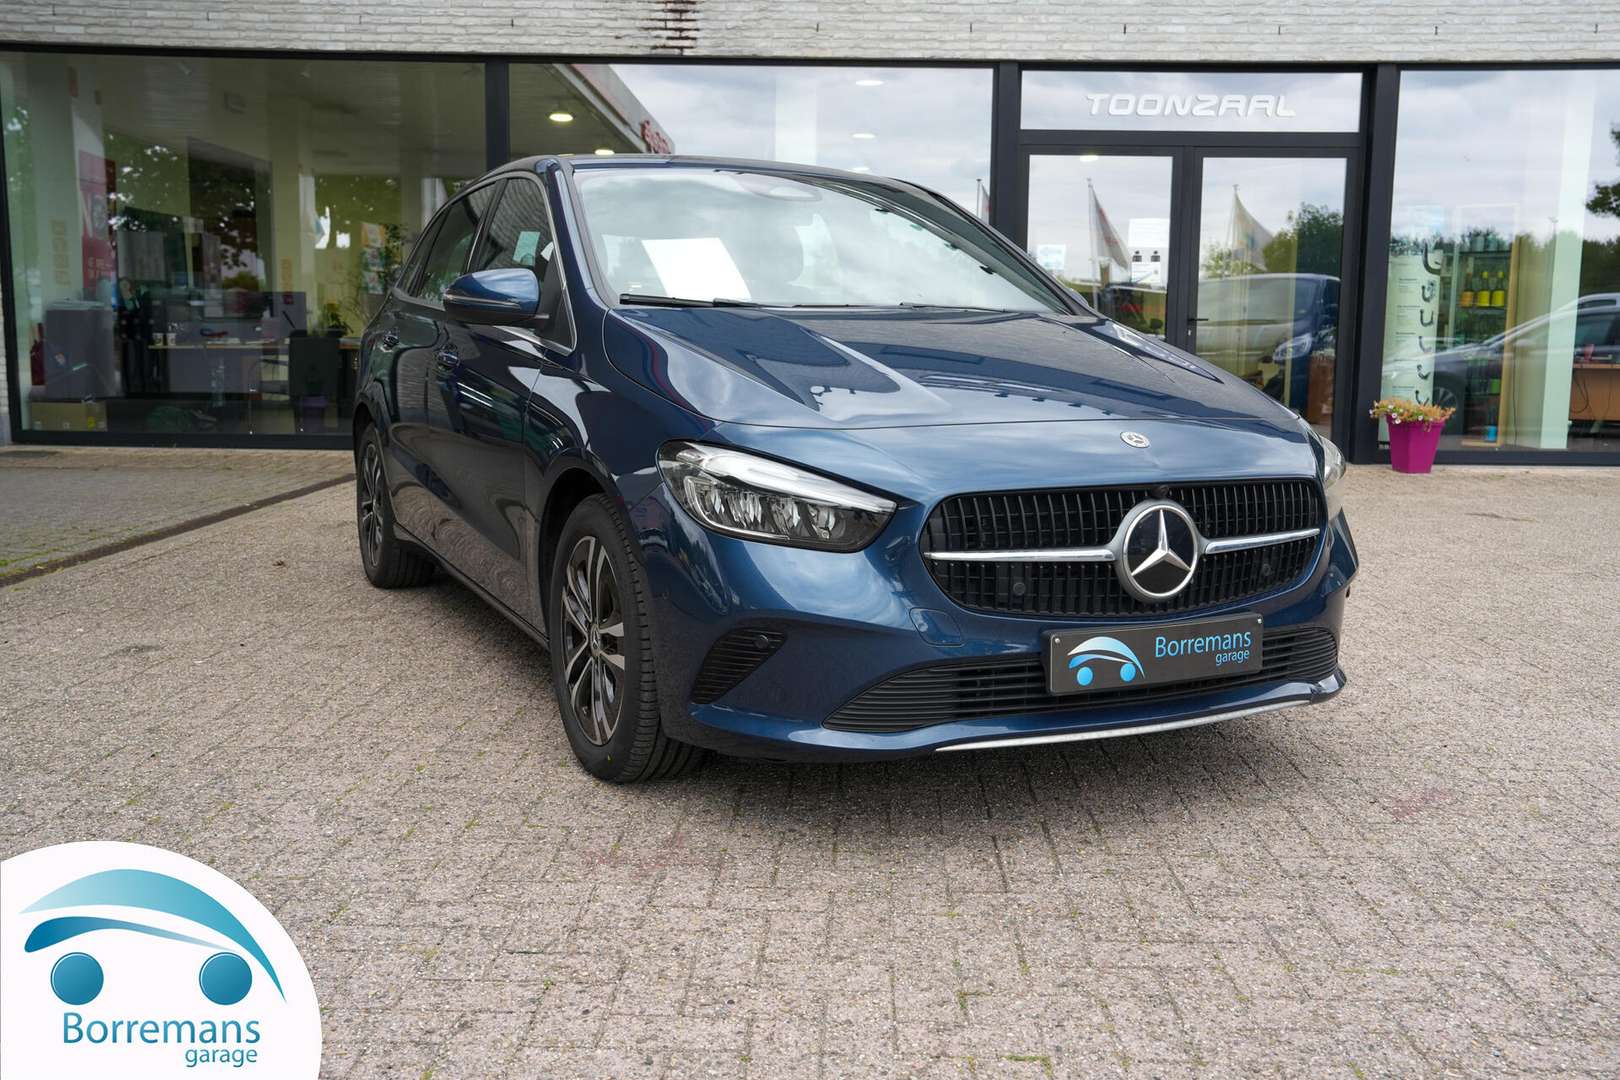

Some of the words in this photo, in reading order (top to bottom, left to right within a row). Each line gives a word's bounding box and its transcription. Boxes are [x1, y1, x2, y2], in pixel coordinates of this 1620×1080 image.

[1086, 93, 1297, 118] TOONZAAL
[1154, 631, 1252, 659] Borremans
[1215, 648, 1250, 667] garage
